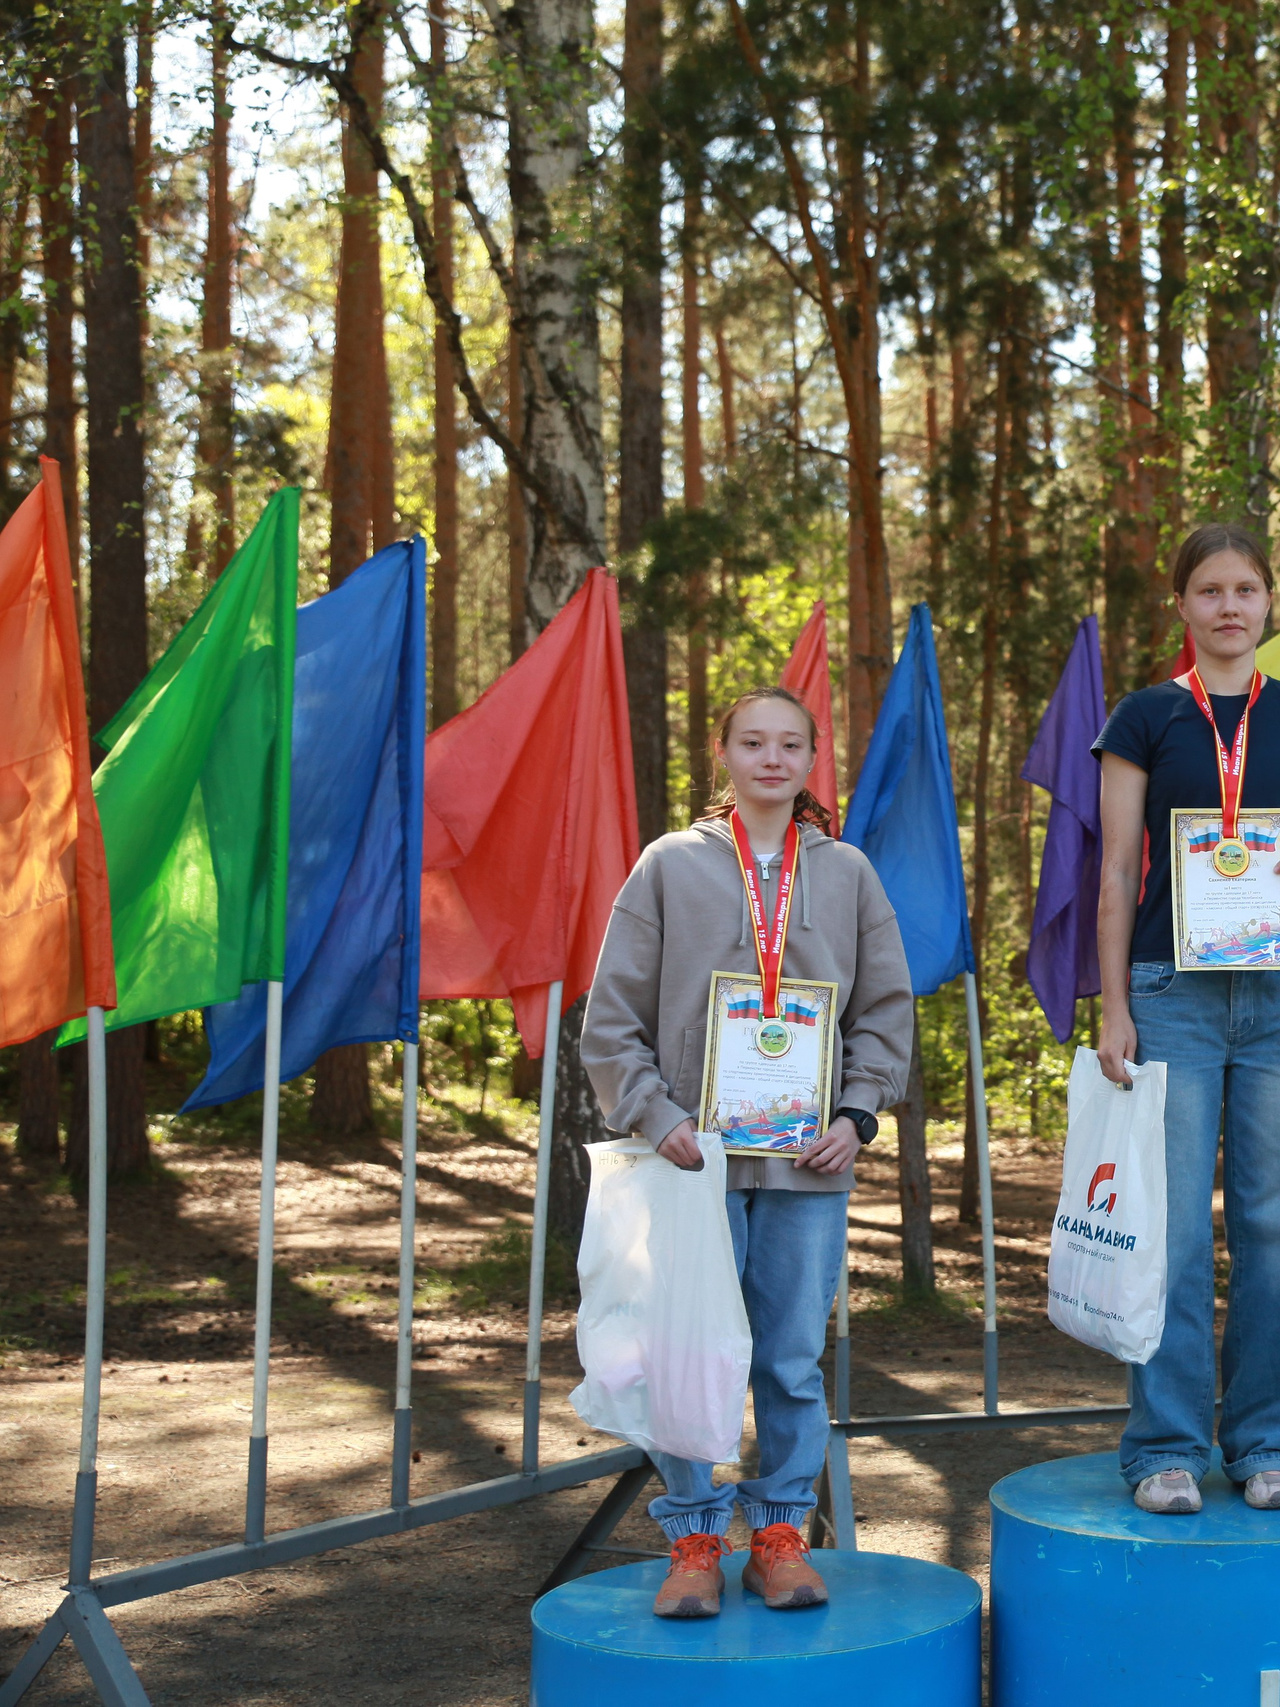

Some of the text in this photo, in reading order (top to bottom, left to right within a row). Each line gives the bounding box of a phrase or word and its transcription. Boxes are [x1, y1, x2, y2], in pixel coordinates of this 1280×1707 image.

[1232, 756, 1240, 776] Иван
[1236, 746, 1242, 756] да
[746, 869, 754, 888] Иван
[750, 890, 757, 900] да
[781, 884, 788, 893] 15
[753, 900, 762, 926] Марья
[776, 896, 788, 922] Марья
[758, 930, 766, 938] 15
[777, 922, 784, 932] да
[772, 934, 782, 954] Иван
[1057, 1214, 1136, 1252] СКАНДИАВИЯ
